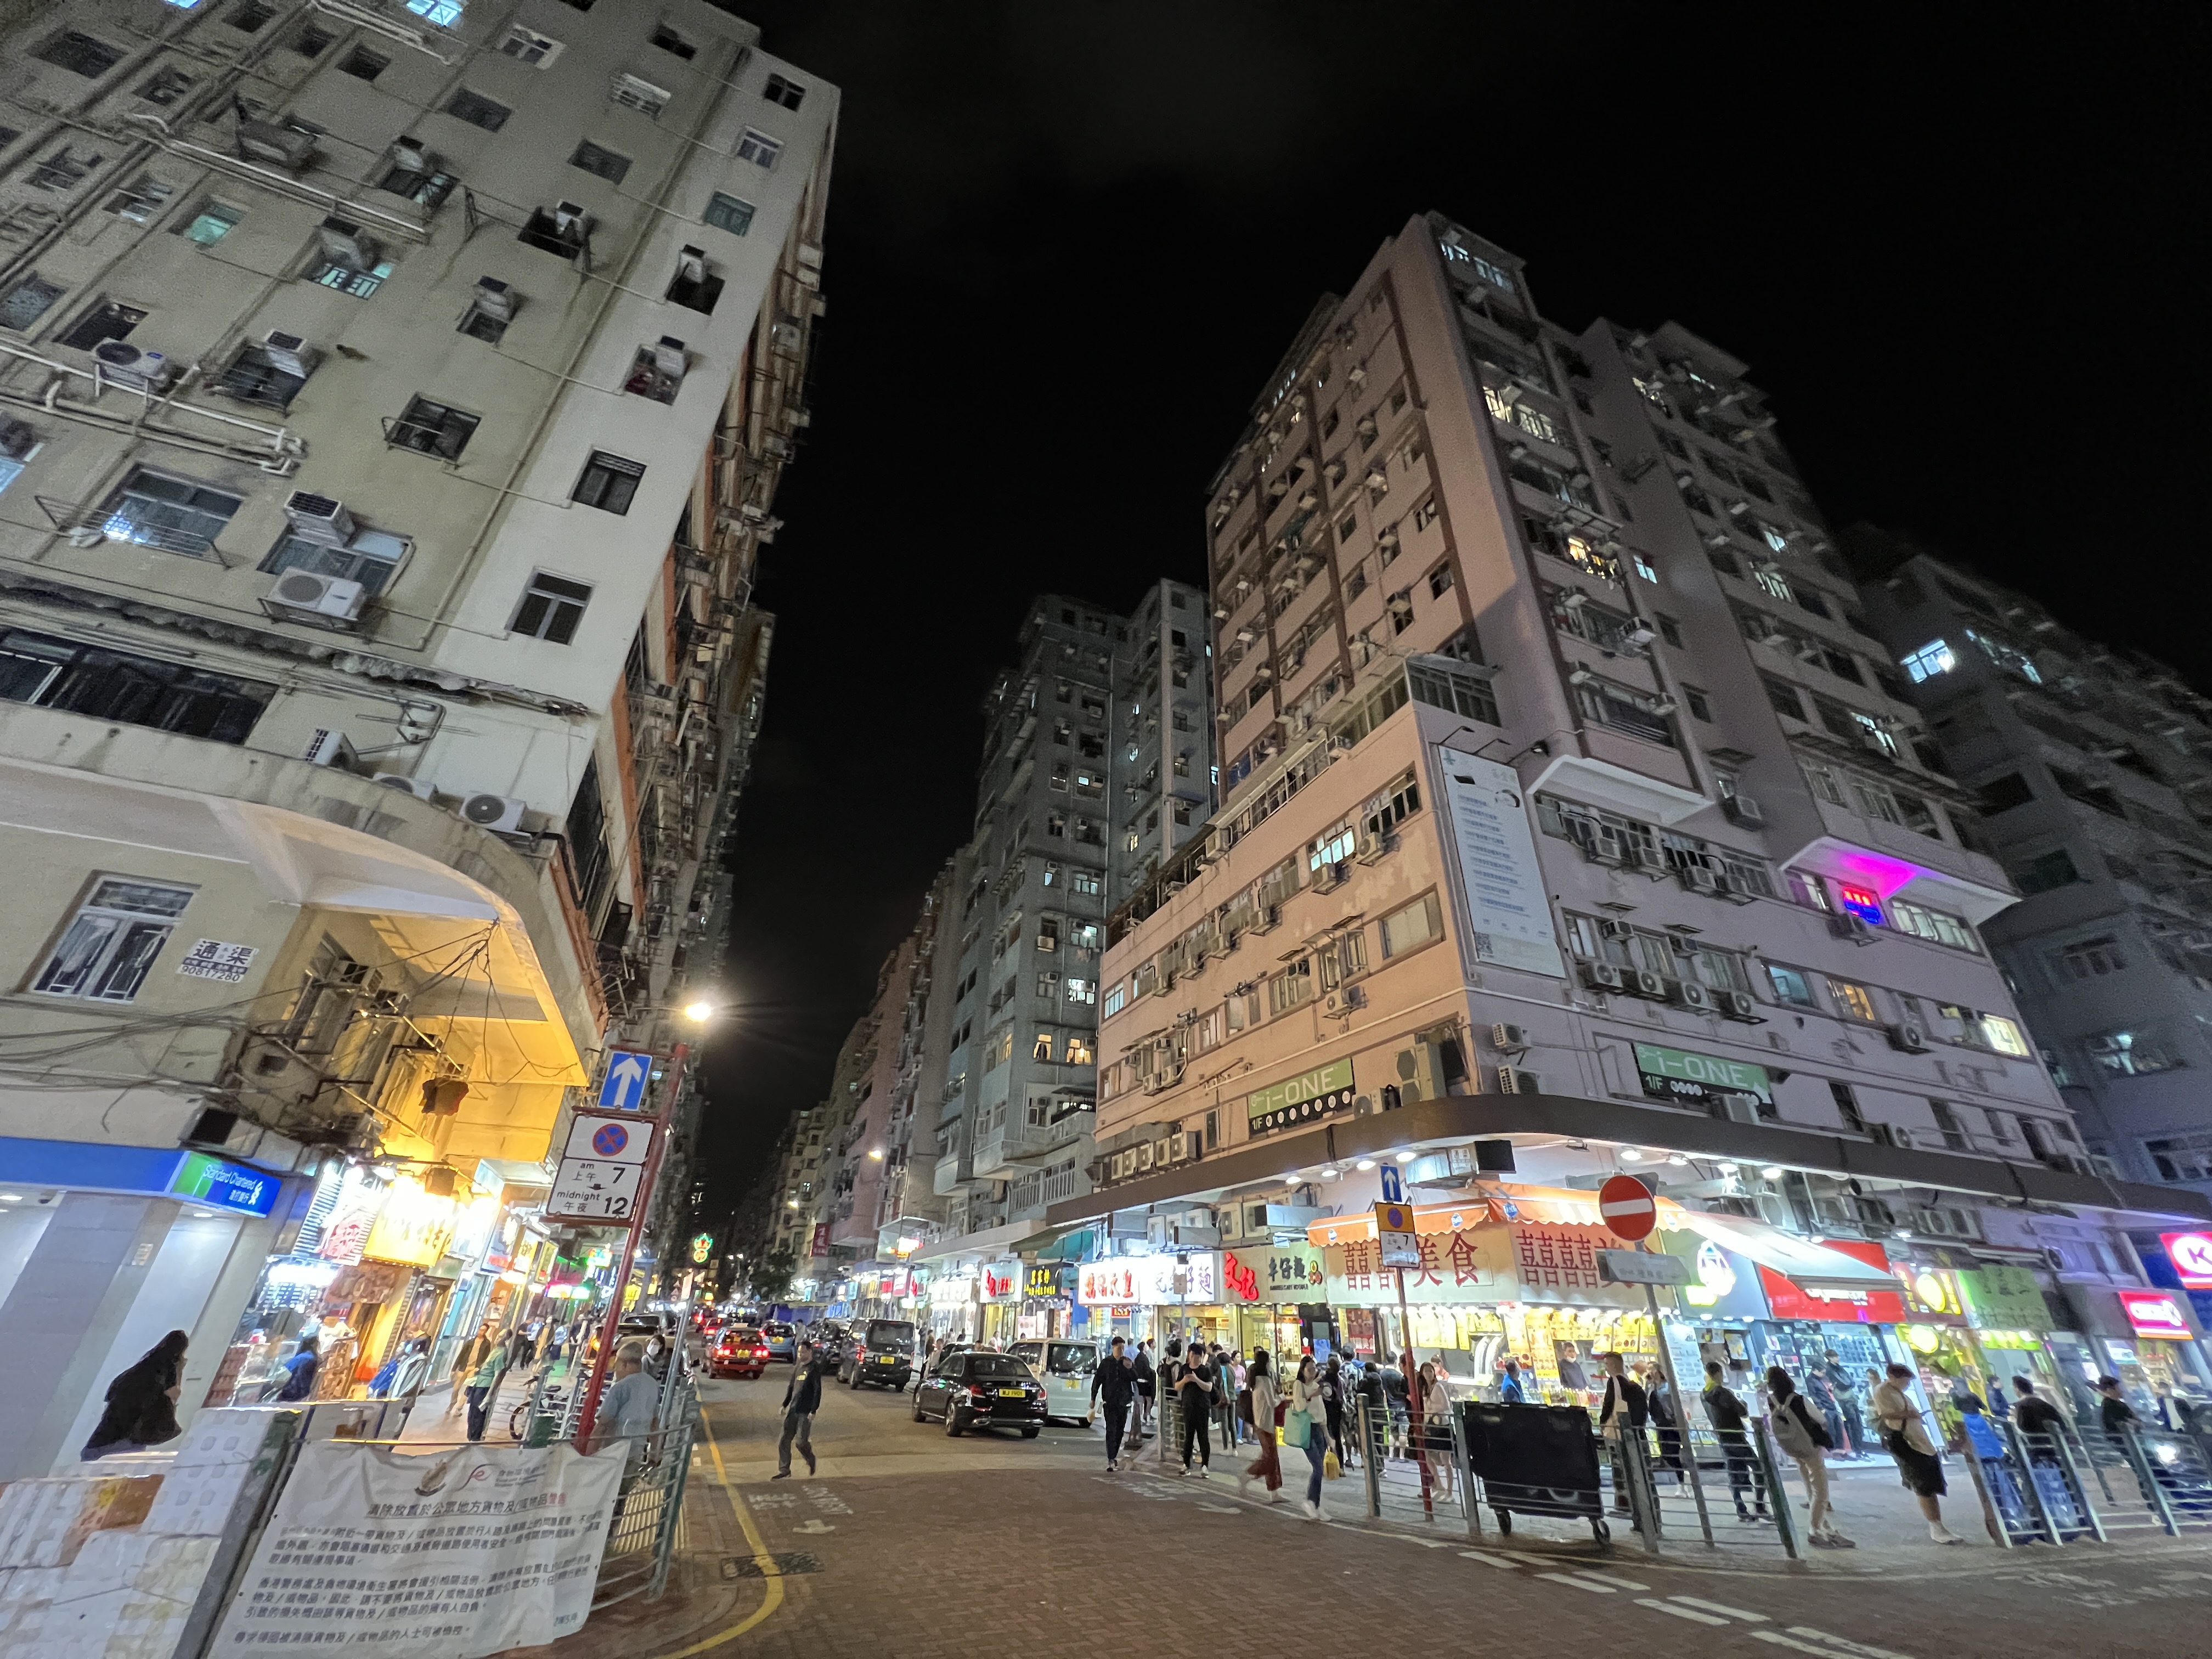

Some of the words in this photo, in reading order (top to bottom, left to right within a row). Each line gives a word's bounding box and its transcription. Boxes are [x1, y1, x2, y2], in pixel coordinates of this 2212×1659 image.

[193, 940, 252, 964] 通渠
[181, 966, 240, 981] 90817280
[1645, 1075, 1663, 1090] 1/F
[1252, 1117, 1262, 1130] 1/F
[572, 1170, 597, 1182] 上午
[612, 1167, 625, 1184] 7
[556, 1190, 600, 1201] midnight
[563, 1201, 589, 1212] 午夜
[604, 1197, 629, 1215] 12
[1403, 1235, 1408, 1246] 7
